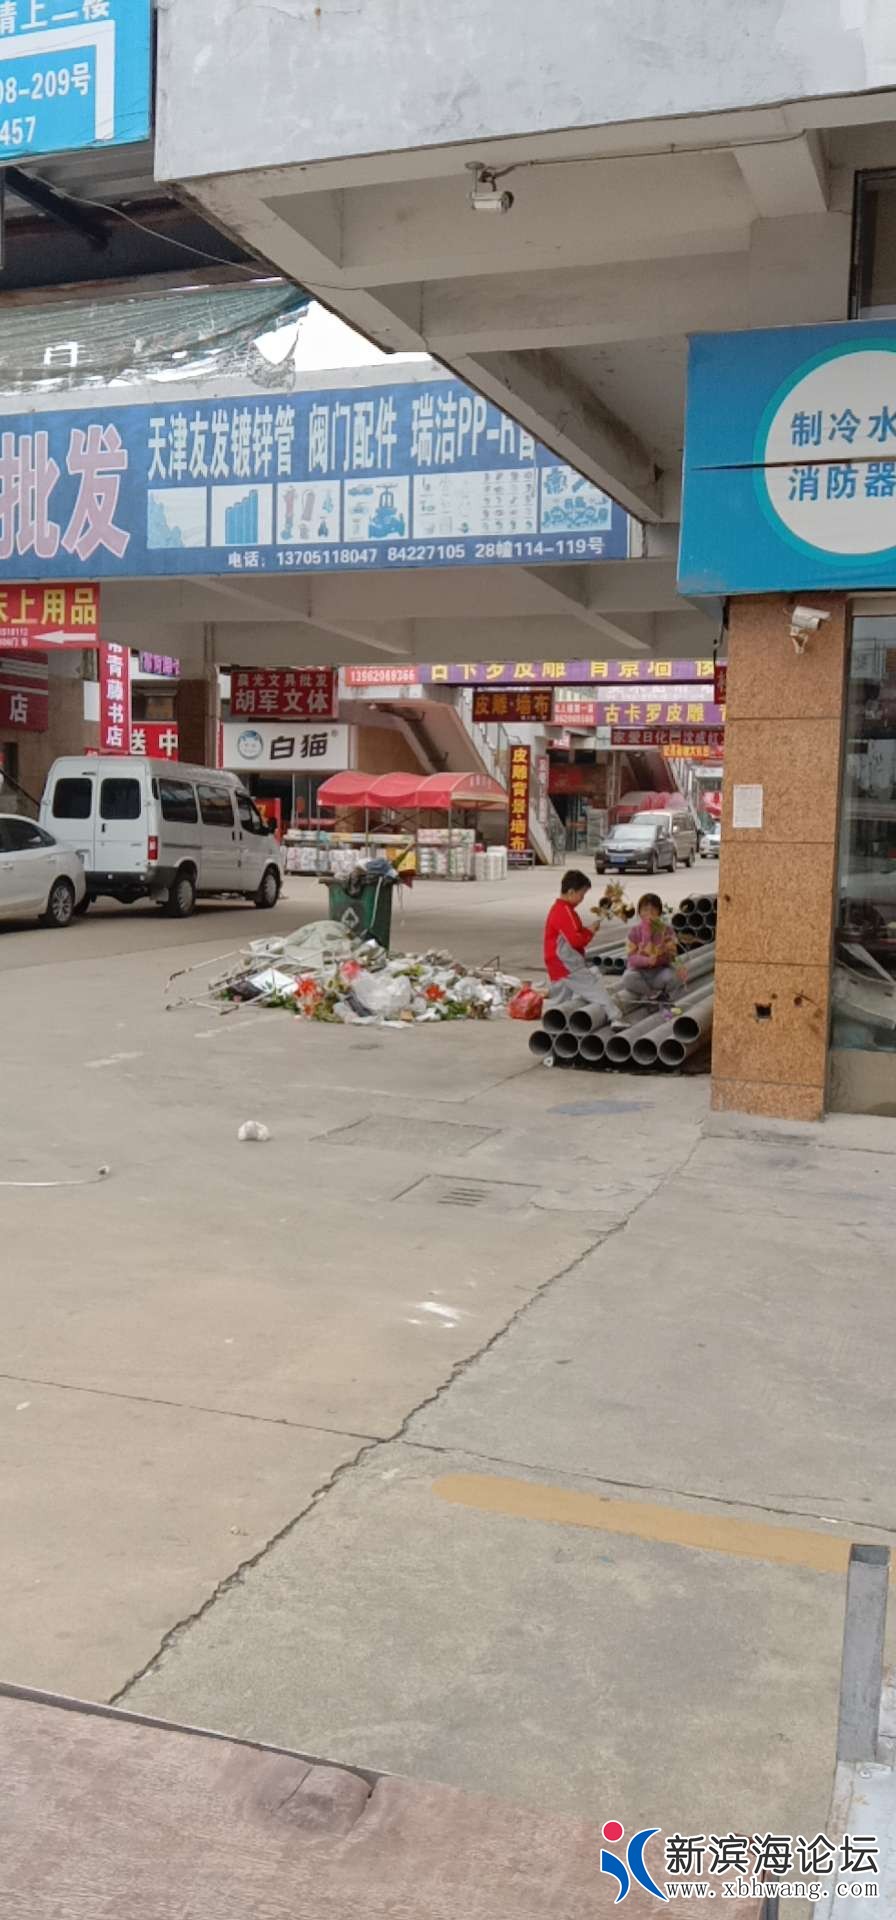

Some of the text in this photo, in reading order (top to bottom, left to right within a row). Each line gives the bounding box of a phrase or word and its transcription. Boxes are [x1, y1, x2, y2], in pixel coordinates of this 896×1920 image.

[0, 62, 91, 105] 8-209号
[147, 403, 296, 481] 天津友发镀锌管
[308, 395, 398, 474] 阀门配件
[790, 405, 896, 447] 制冷水
[0, 422, 130, 561] 批发
[788, 463, 896, 502] 消防器
[277, 547, 378, 566] 13705118047
[387, 543, 465, 562] 84227105
[235, 688, 329, 713] 胡军文体
[604, 703, 705, 724] 古卡罗皮雕
[269, 731, 329, 760] 白猫
